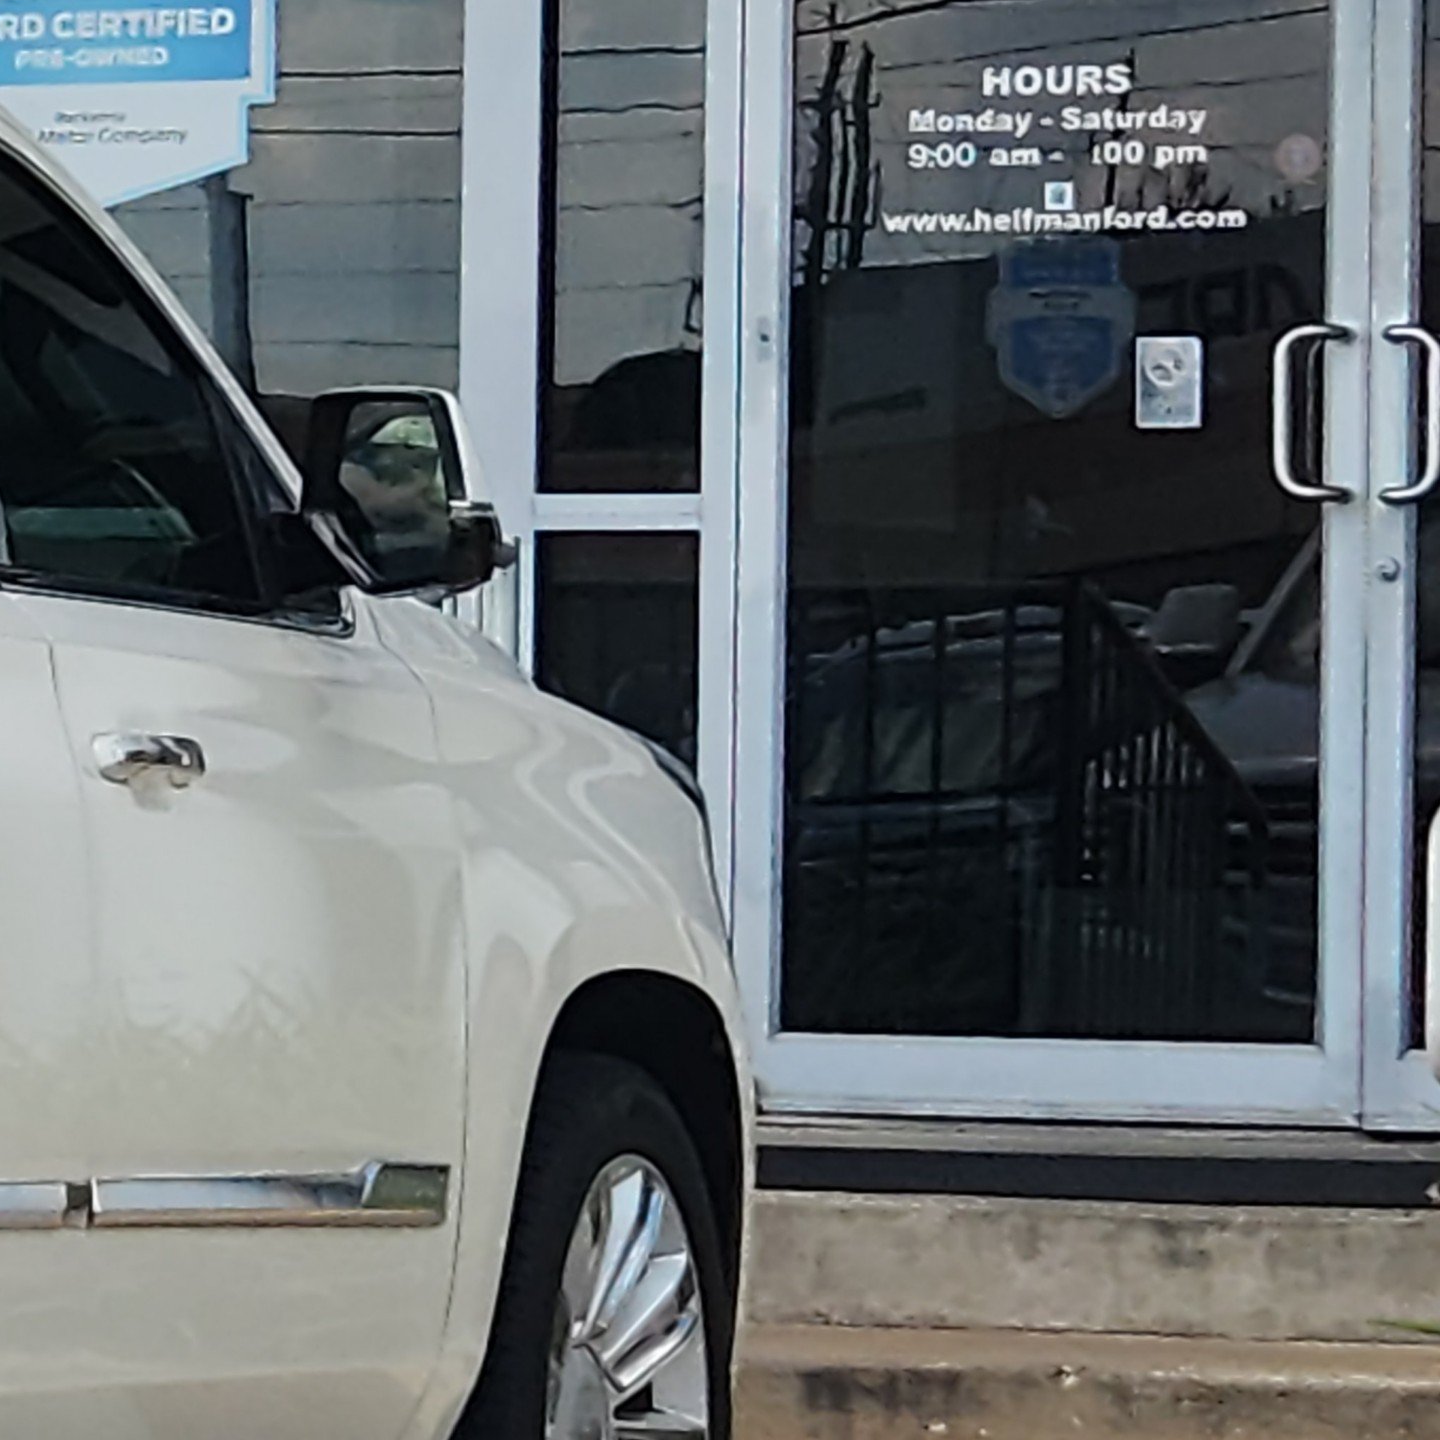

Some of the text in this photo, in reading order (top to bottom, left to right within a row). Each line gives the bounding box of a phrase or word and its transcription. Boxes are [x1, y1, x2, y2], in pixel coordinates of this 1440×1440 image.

[51, 7, 236, 39] CERTIFIED
[981, 63, 1133, 97] HOURS
[908, 108, 1033, 138] Monday
[1060, 105, 1208, 135] Saturday
[907, 142, 978, 169] 9:00
[988, 146, 1042, 167] am
[1154, 143, 1209, 170] pm
[881, 205, 1248, 234] www.helfmanford.com
